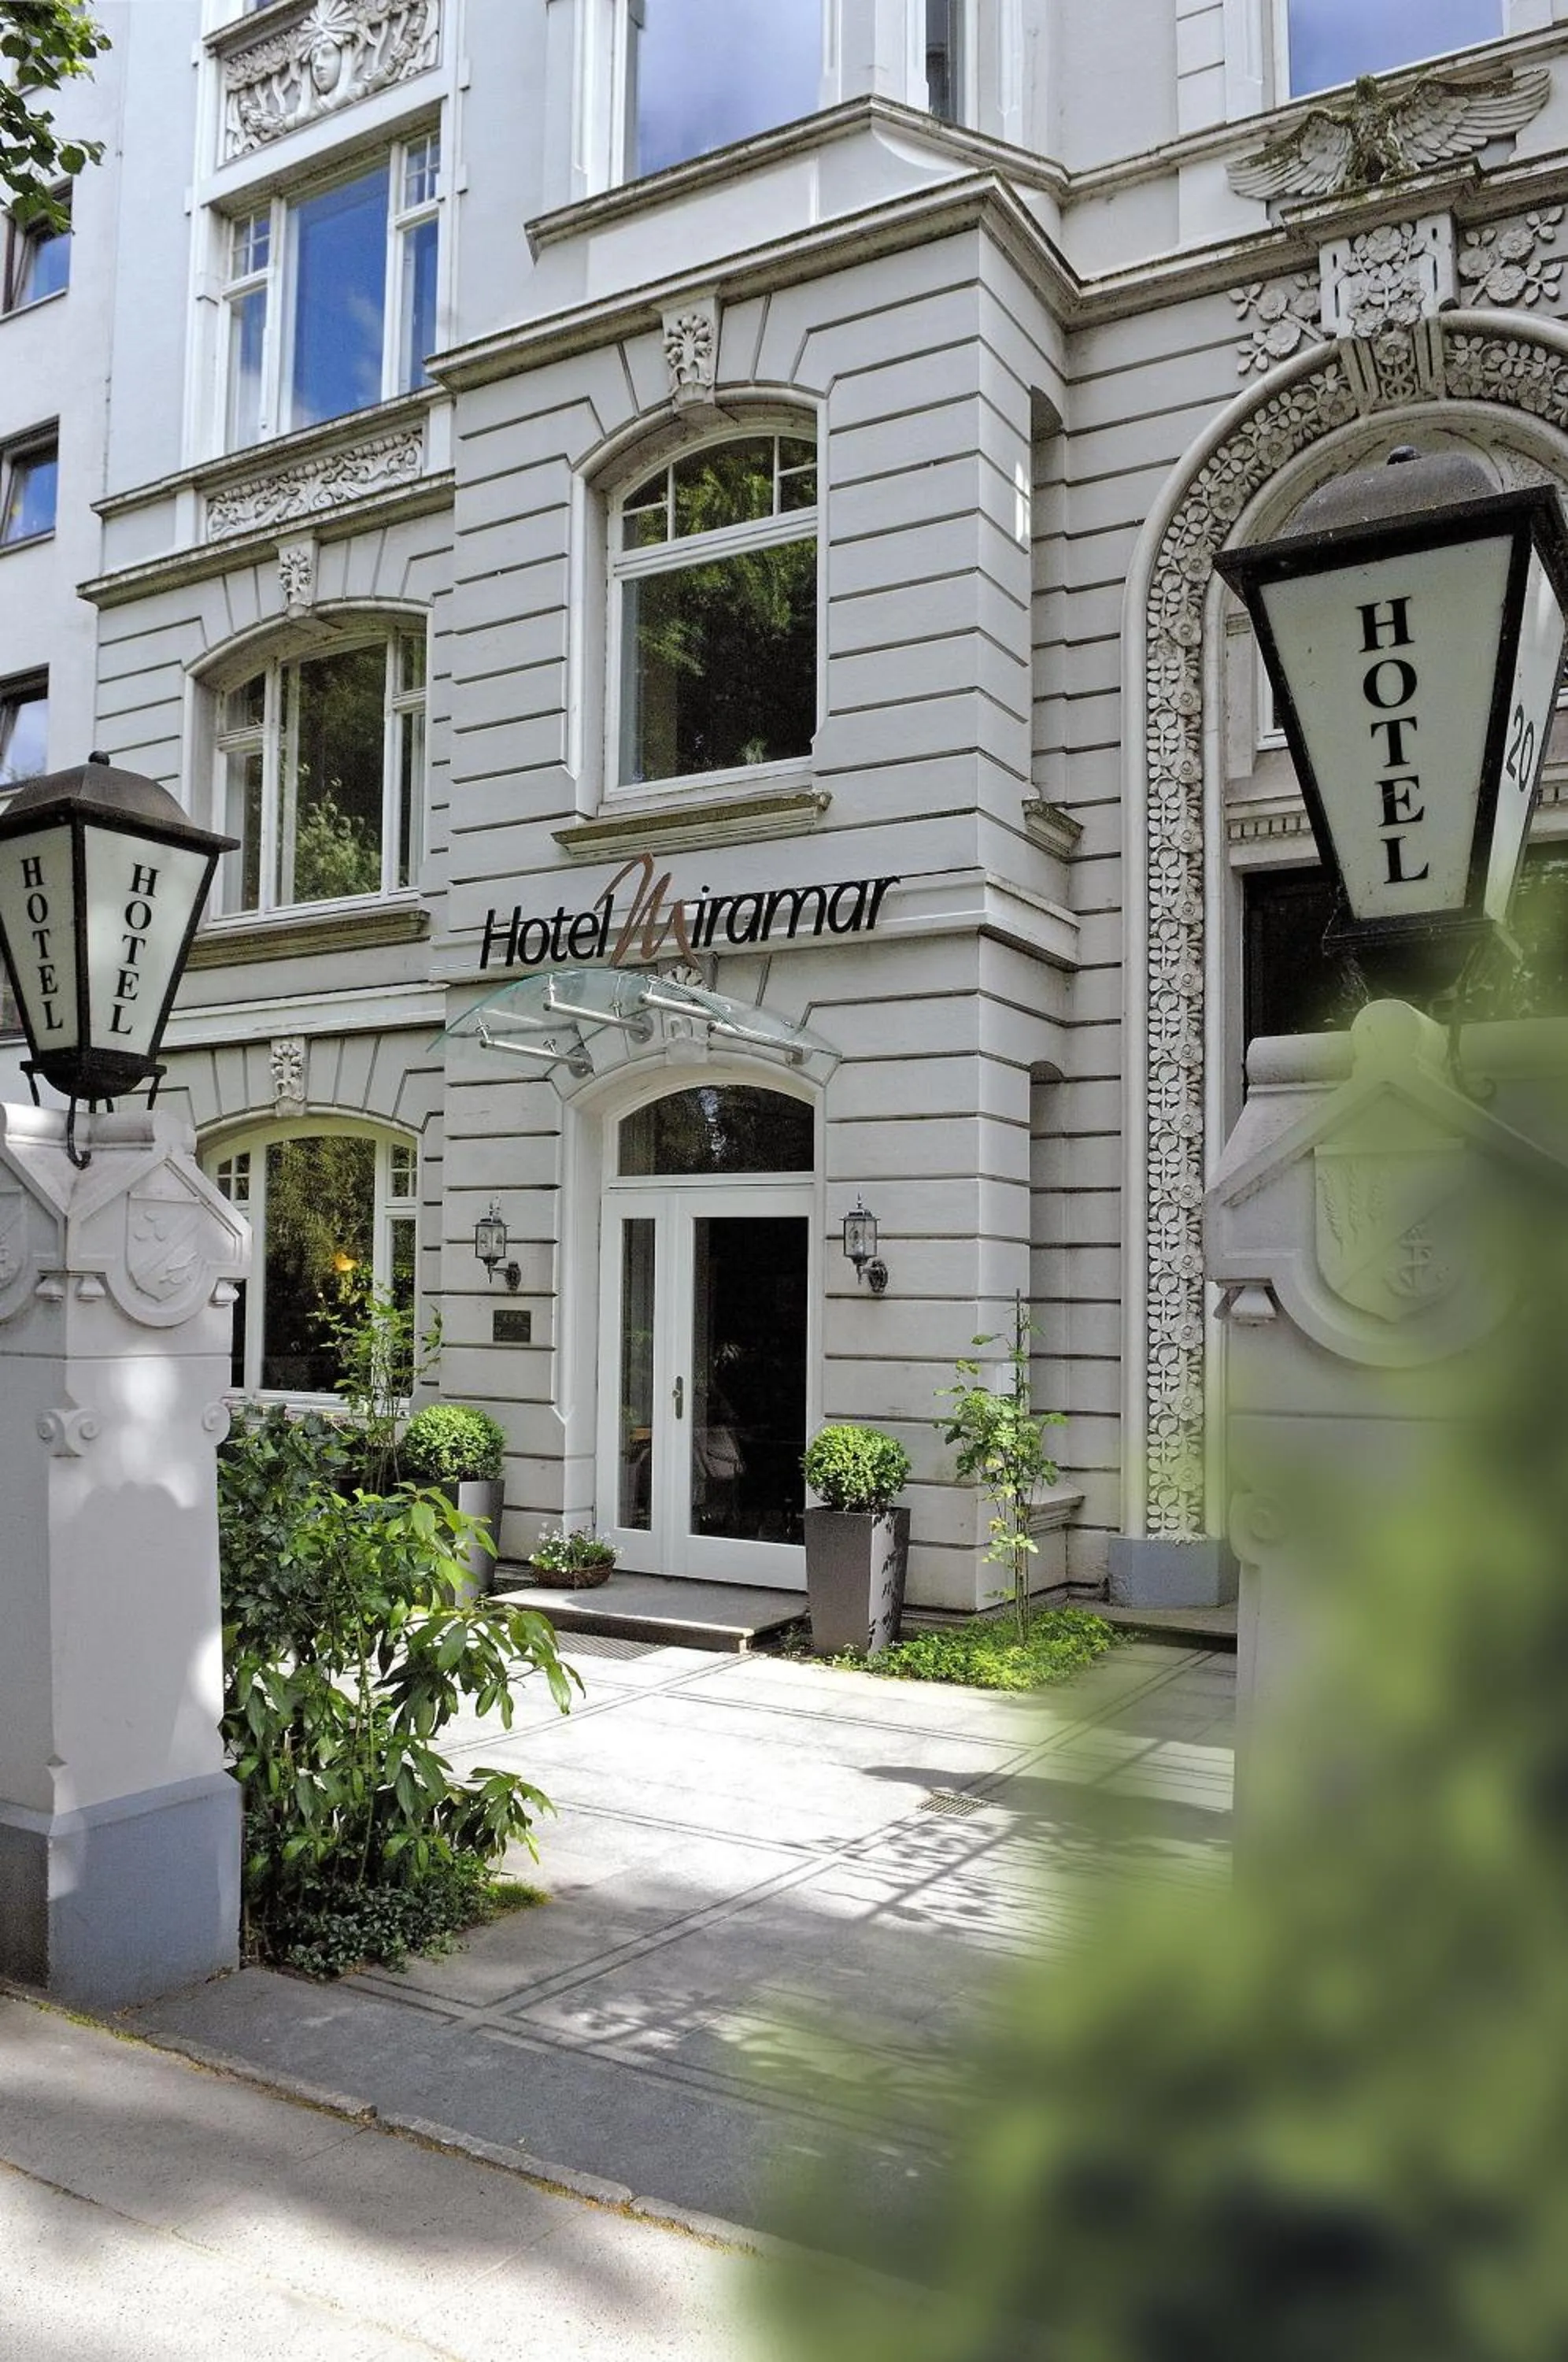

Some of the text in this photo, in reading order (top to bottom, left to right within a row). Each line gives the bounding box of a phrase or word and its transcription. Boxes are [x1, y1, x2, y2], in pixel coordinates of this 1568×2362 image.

[1355, 596, 1429, 885] HOTEL
[1506, 704, 1534, 793] 20
[20, 856, 63, 1031] HOTEL
[109, 863, 161, 1035] HOTEL
[479, 850, 900, 970] Hotel Miramar
